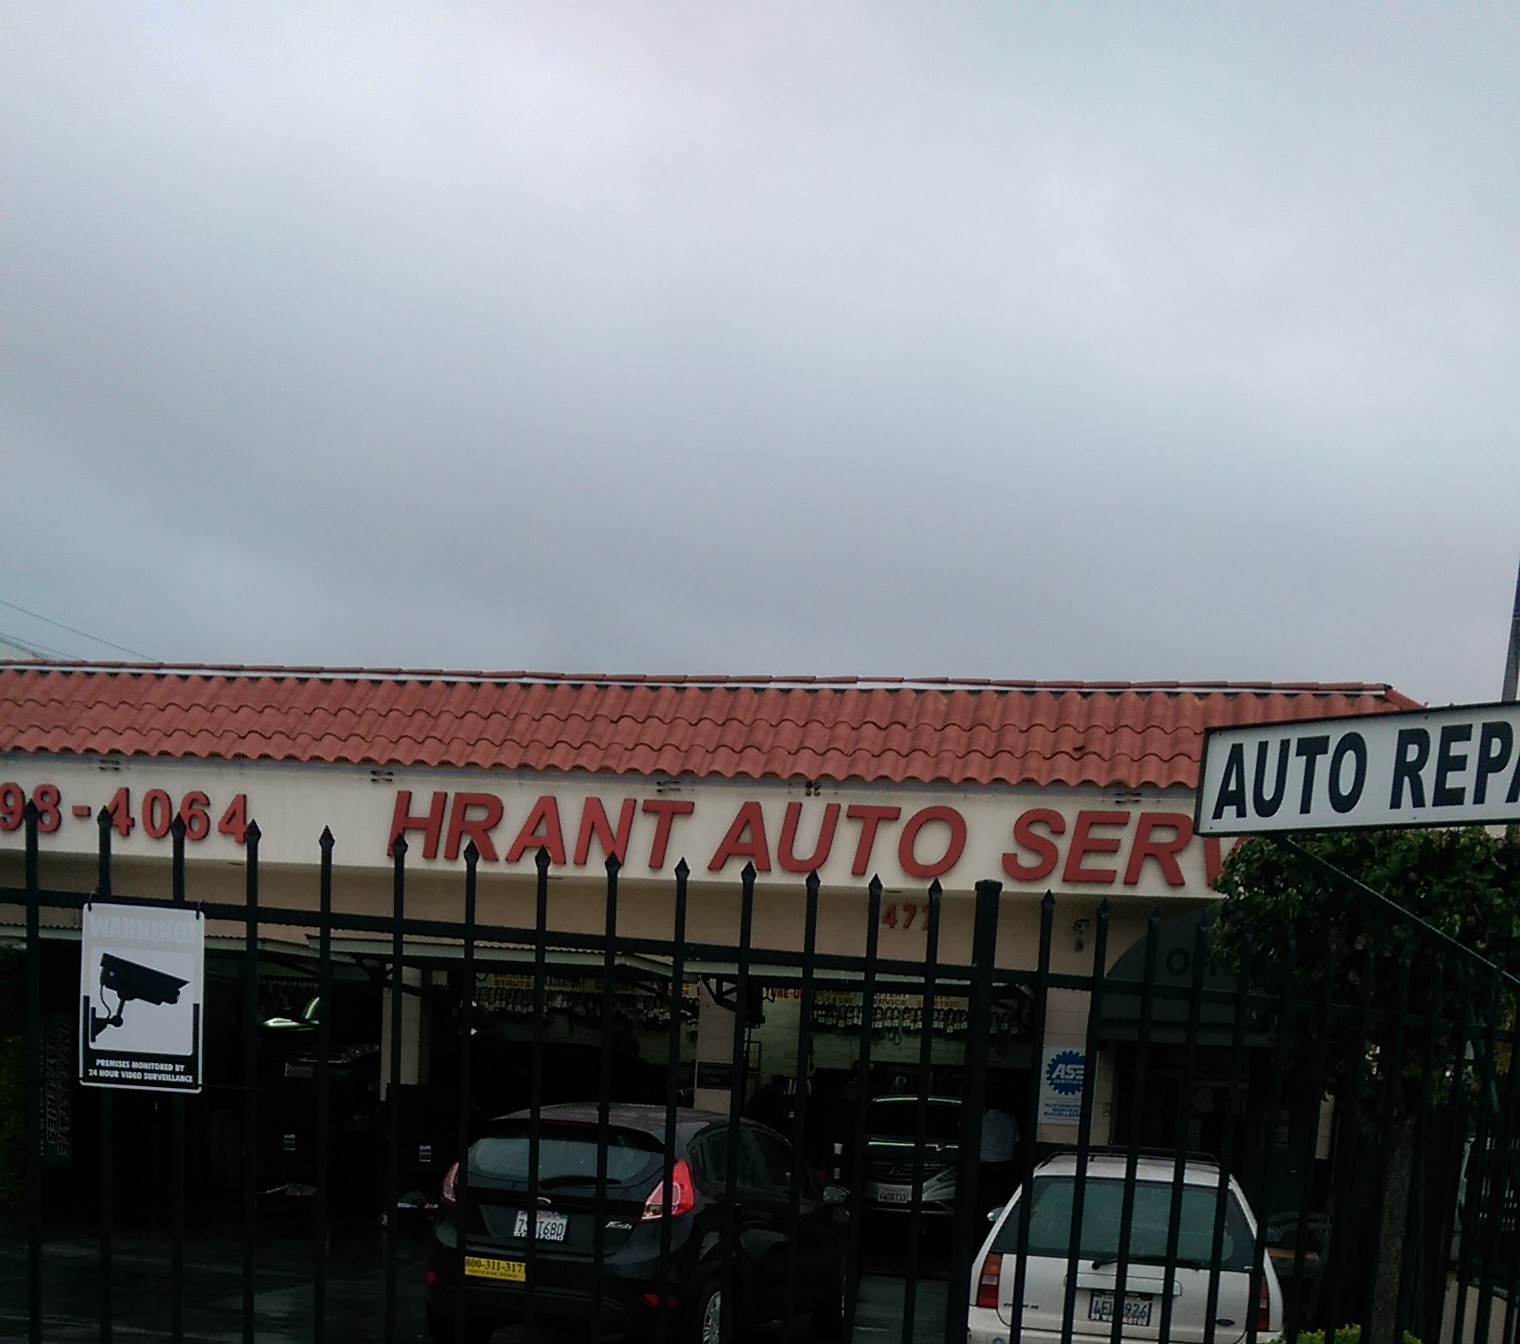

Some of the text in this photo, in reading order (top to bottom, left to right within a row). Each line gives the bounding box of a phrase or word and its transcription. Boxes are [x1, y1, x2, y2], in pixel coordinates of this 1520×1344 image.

[1212, 721, 1520, 819] AUTO REP
[0, 782, 247, 843] 98-4064
[387, 790, 696, 867] HRANT
[708, 802, 967, 879] AUTO
[88, 1068, 194, 1083] 24 HOUR VIDEO SURVEILLANCE
[95, 1059, 186, 1073] PREMISES MONITORED BY
[1051, 1063, 1085, 1080] ASE
